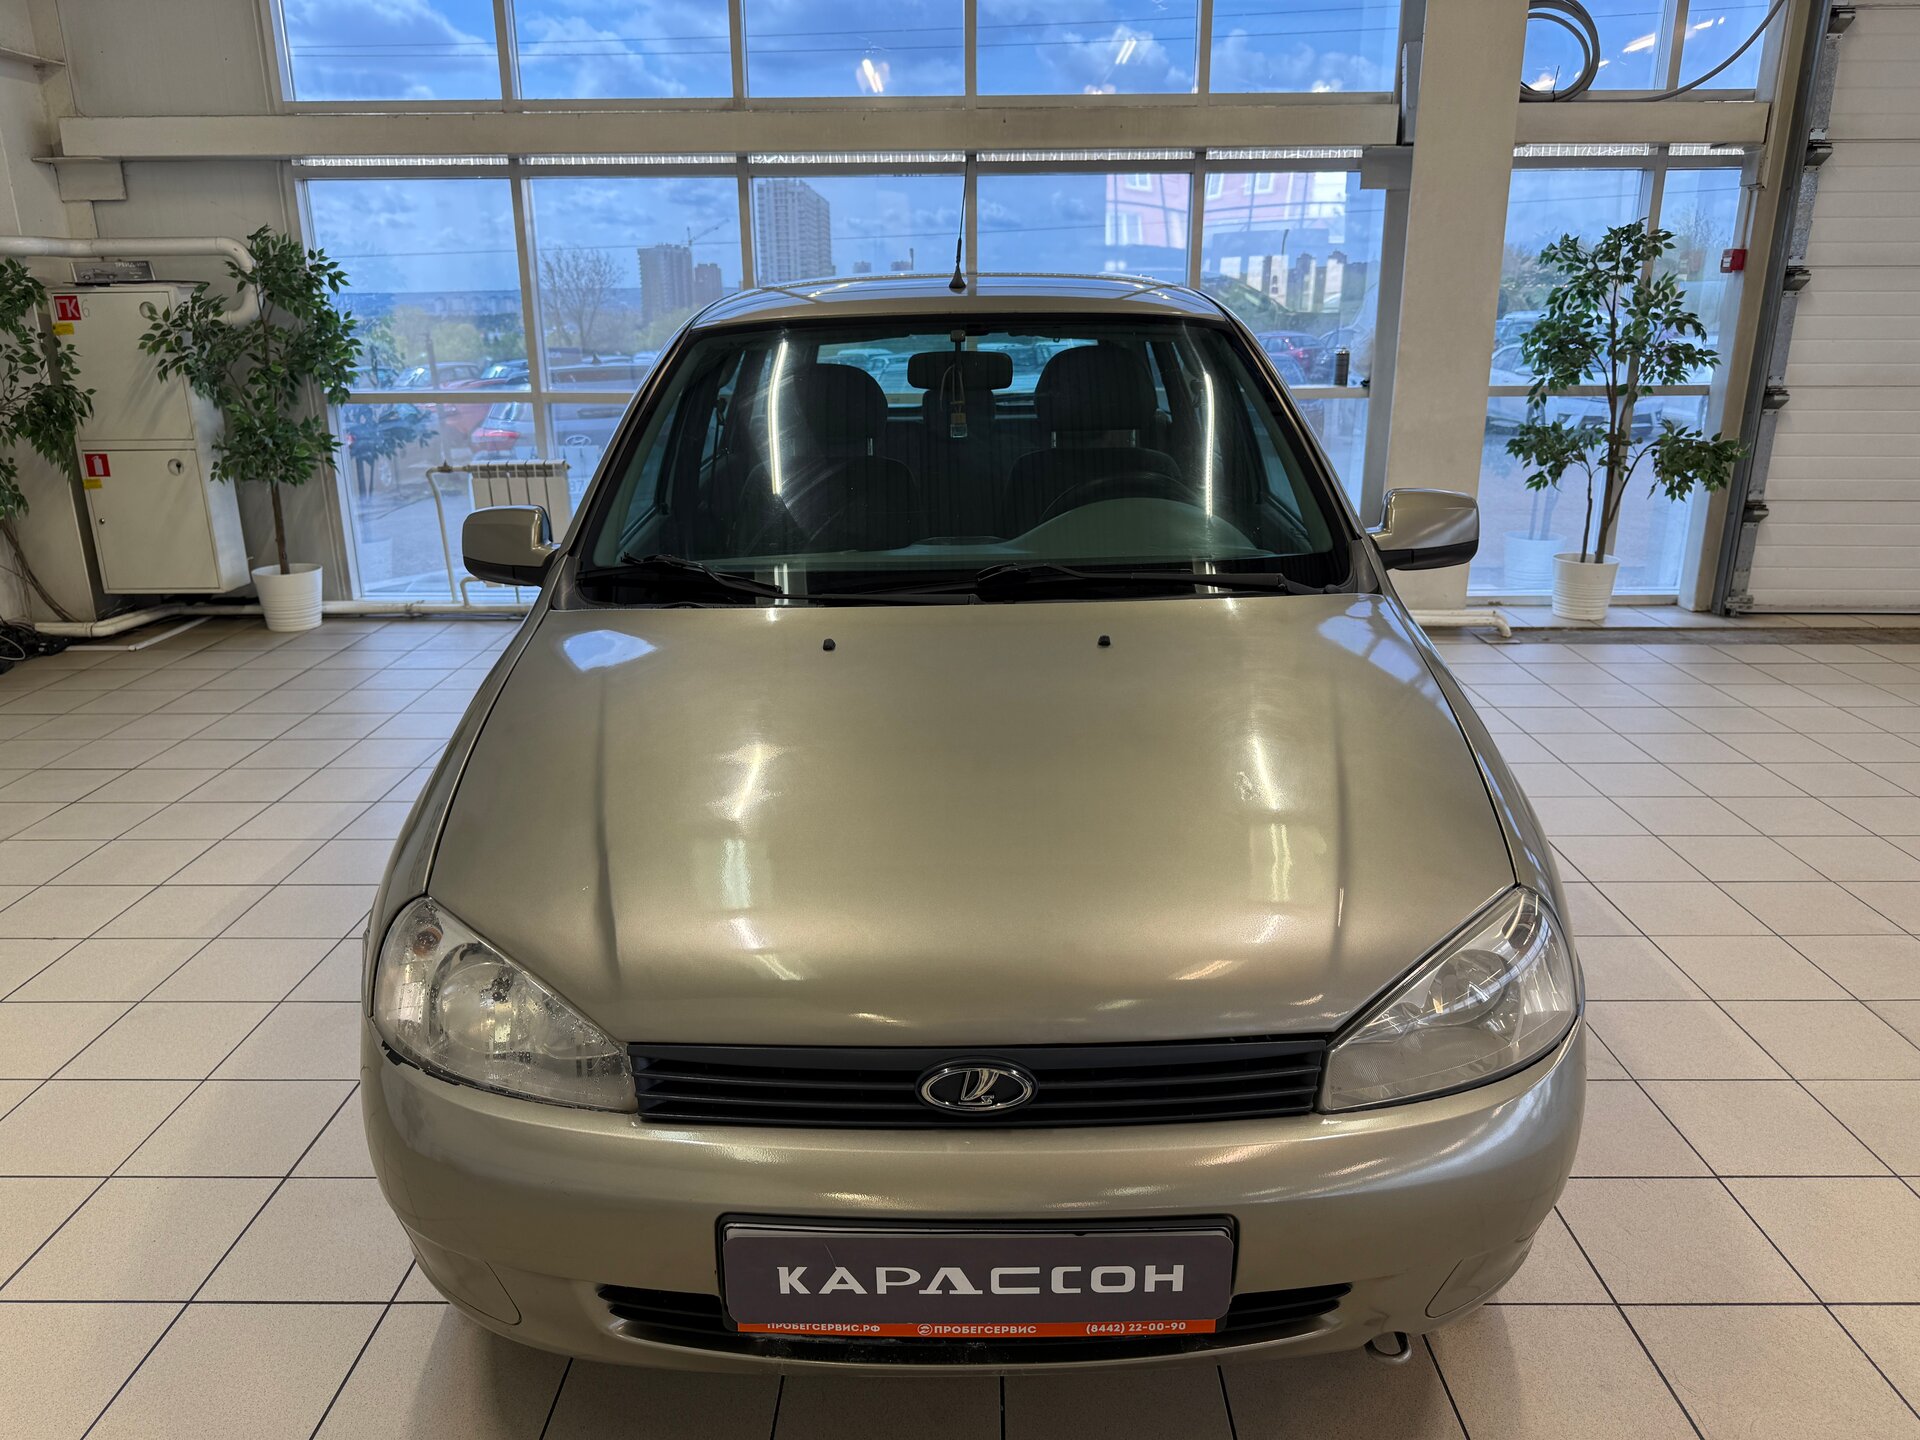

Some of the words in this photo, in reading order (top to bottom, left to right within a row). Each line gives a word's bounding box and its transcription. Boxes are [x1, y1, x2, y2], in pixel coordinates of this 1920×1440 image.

[55, 298, 80, 318] ПК
[767, 1322, 881, 1333] ПРОБЕГСЕРВИС.РФ
[933, 1324, 1037, 1335] ПРОБЕГСЕРВИС
[1085, 1323, 1125, 1334] (8442)
[1128, 1321, 1187, 1333] 22-00-90
